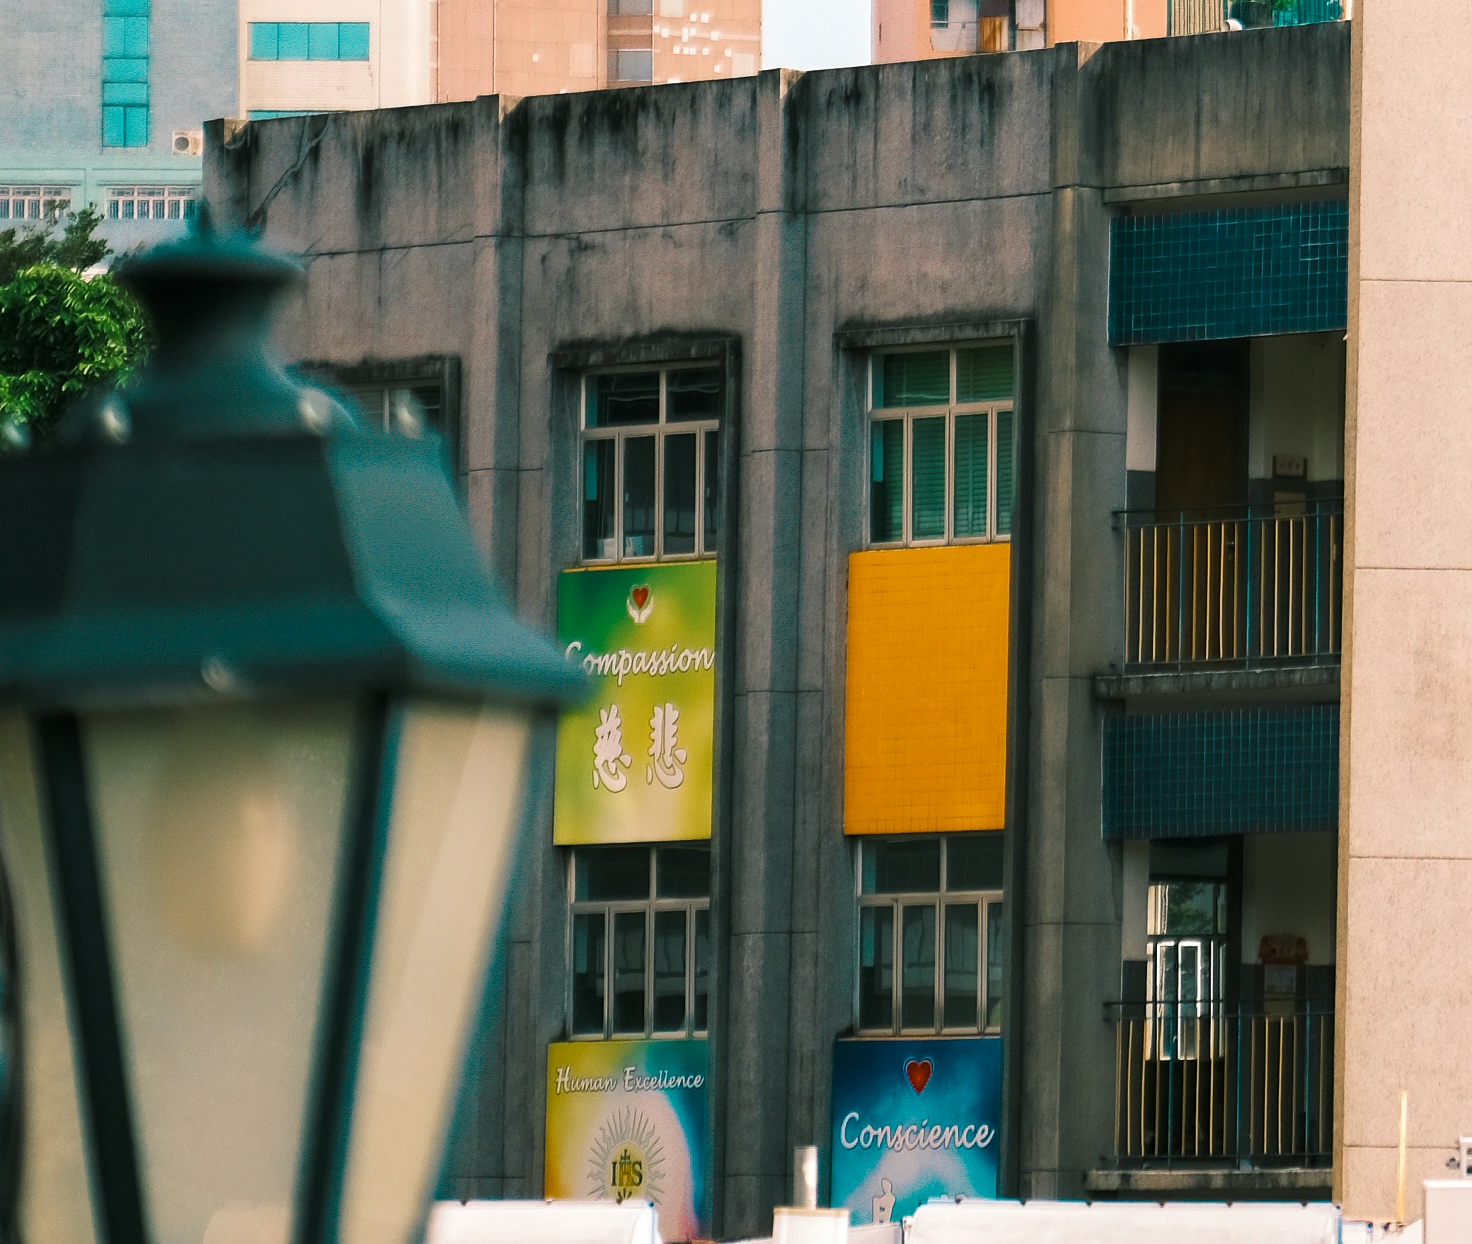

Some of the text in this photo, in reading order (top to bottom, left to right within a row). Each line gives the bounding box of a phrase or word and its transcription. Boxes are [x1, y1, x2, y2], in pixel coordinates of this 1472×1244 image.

[592, 702, 687, 793] 慈悲
[555, 1065, 705, 1095] Human Excellence
[840, 1111, 995, 1153] Conscience
